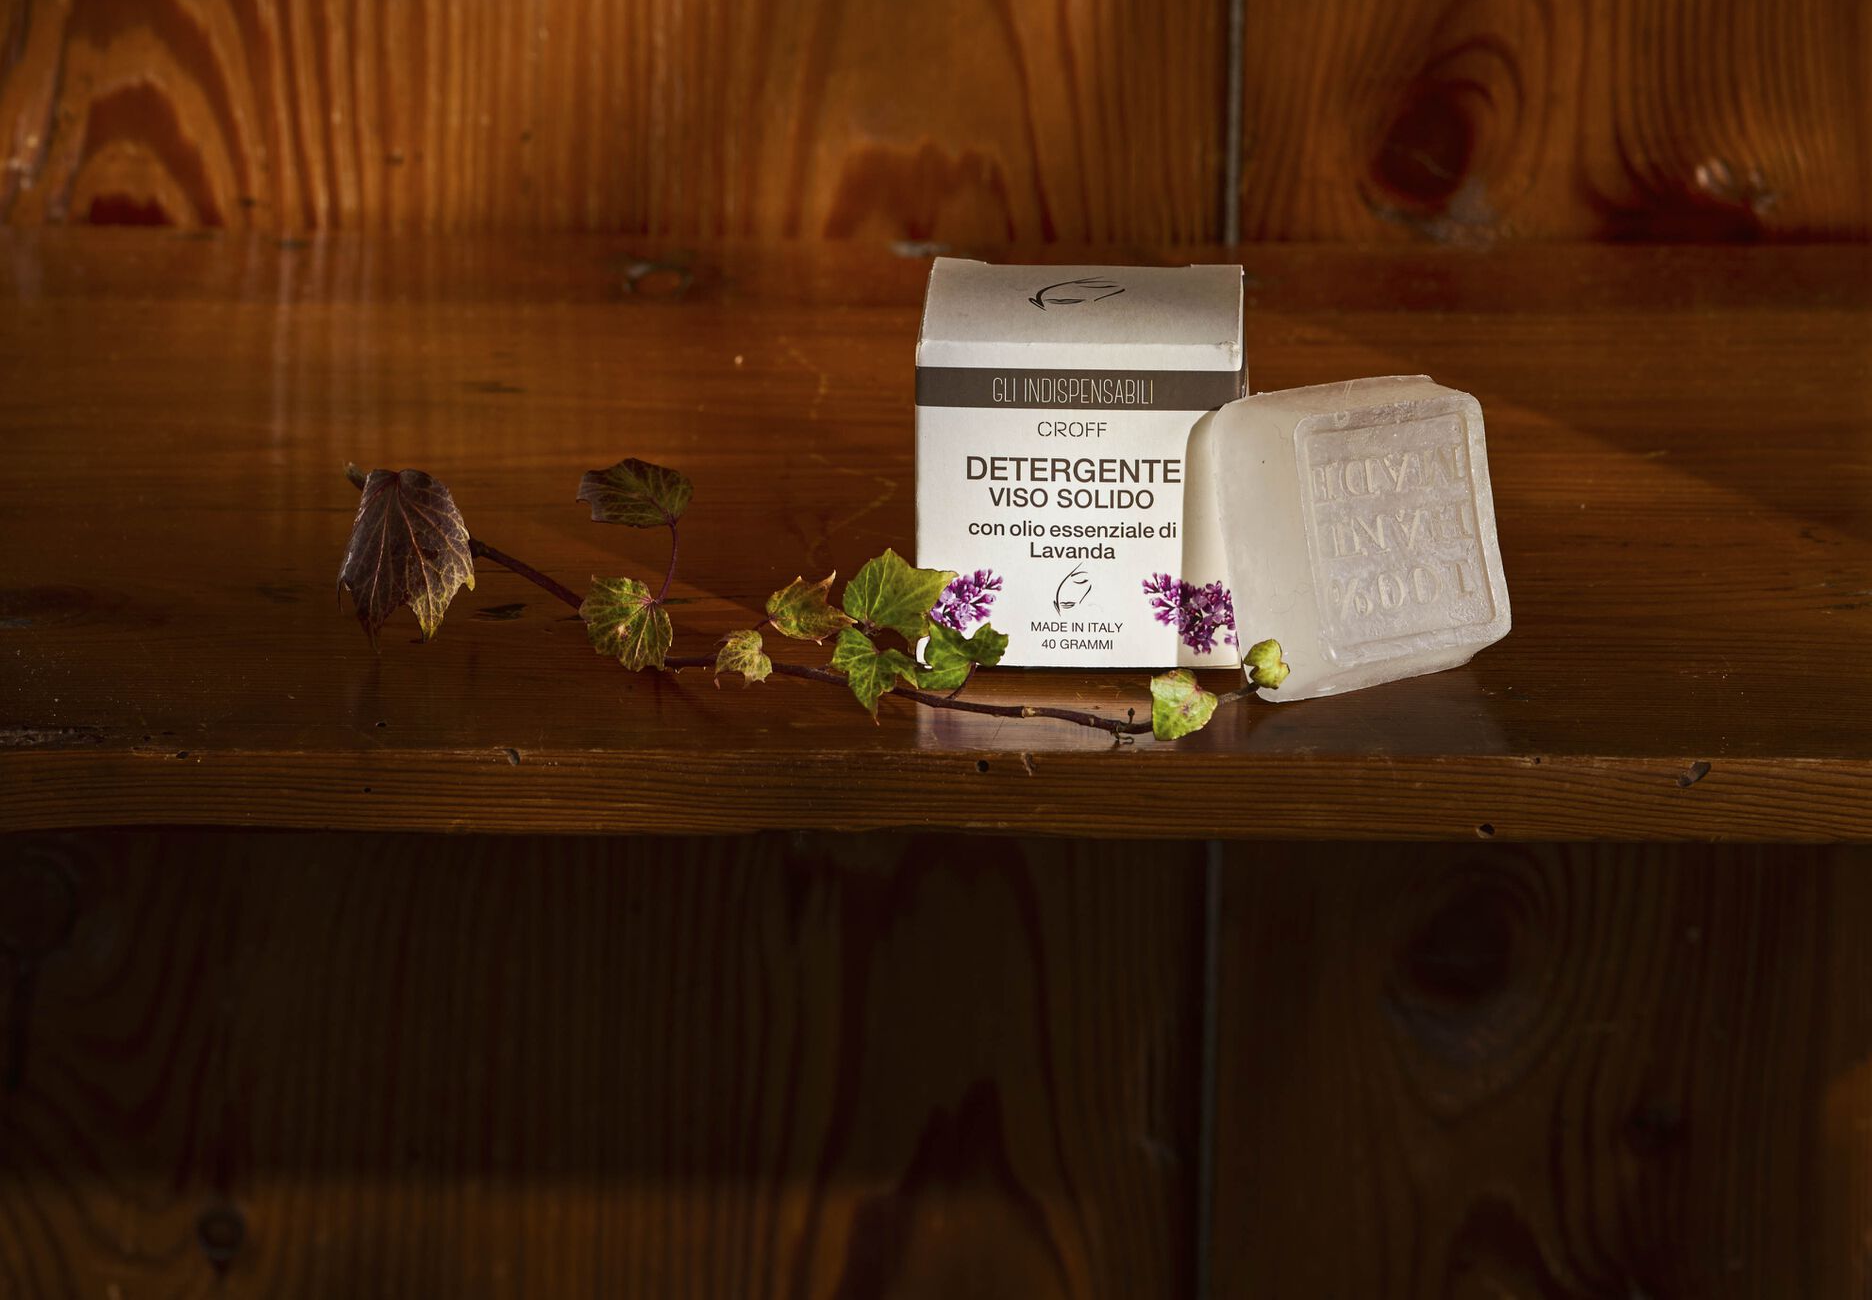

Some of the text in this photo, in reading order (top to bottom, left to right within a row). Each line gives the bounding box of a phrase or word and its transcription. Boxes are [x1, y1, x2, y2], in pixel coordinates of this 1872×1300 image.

[992, 377, 1154, 404] GLI INDISPENSABILI
[1037, 421, 1107, 438] CROFF
[966, 456, 1181, 483] DETERGENTE
[989, 487, 1154, 509] VISO SOLIDO
[968, 520, 1177, 539] con olio essenziale di
[1029, 542, 1116, 559] Lavanda
[1030, 621, 1124, 634] MADE IN ITALY
[1041, 638, 1114, 651] 40 GRAMMI
